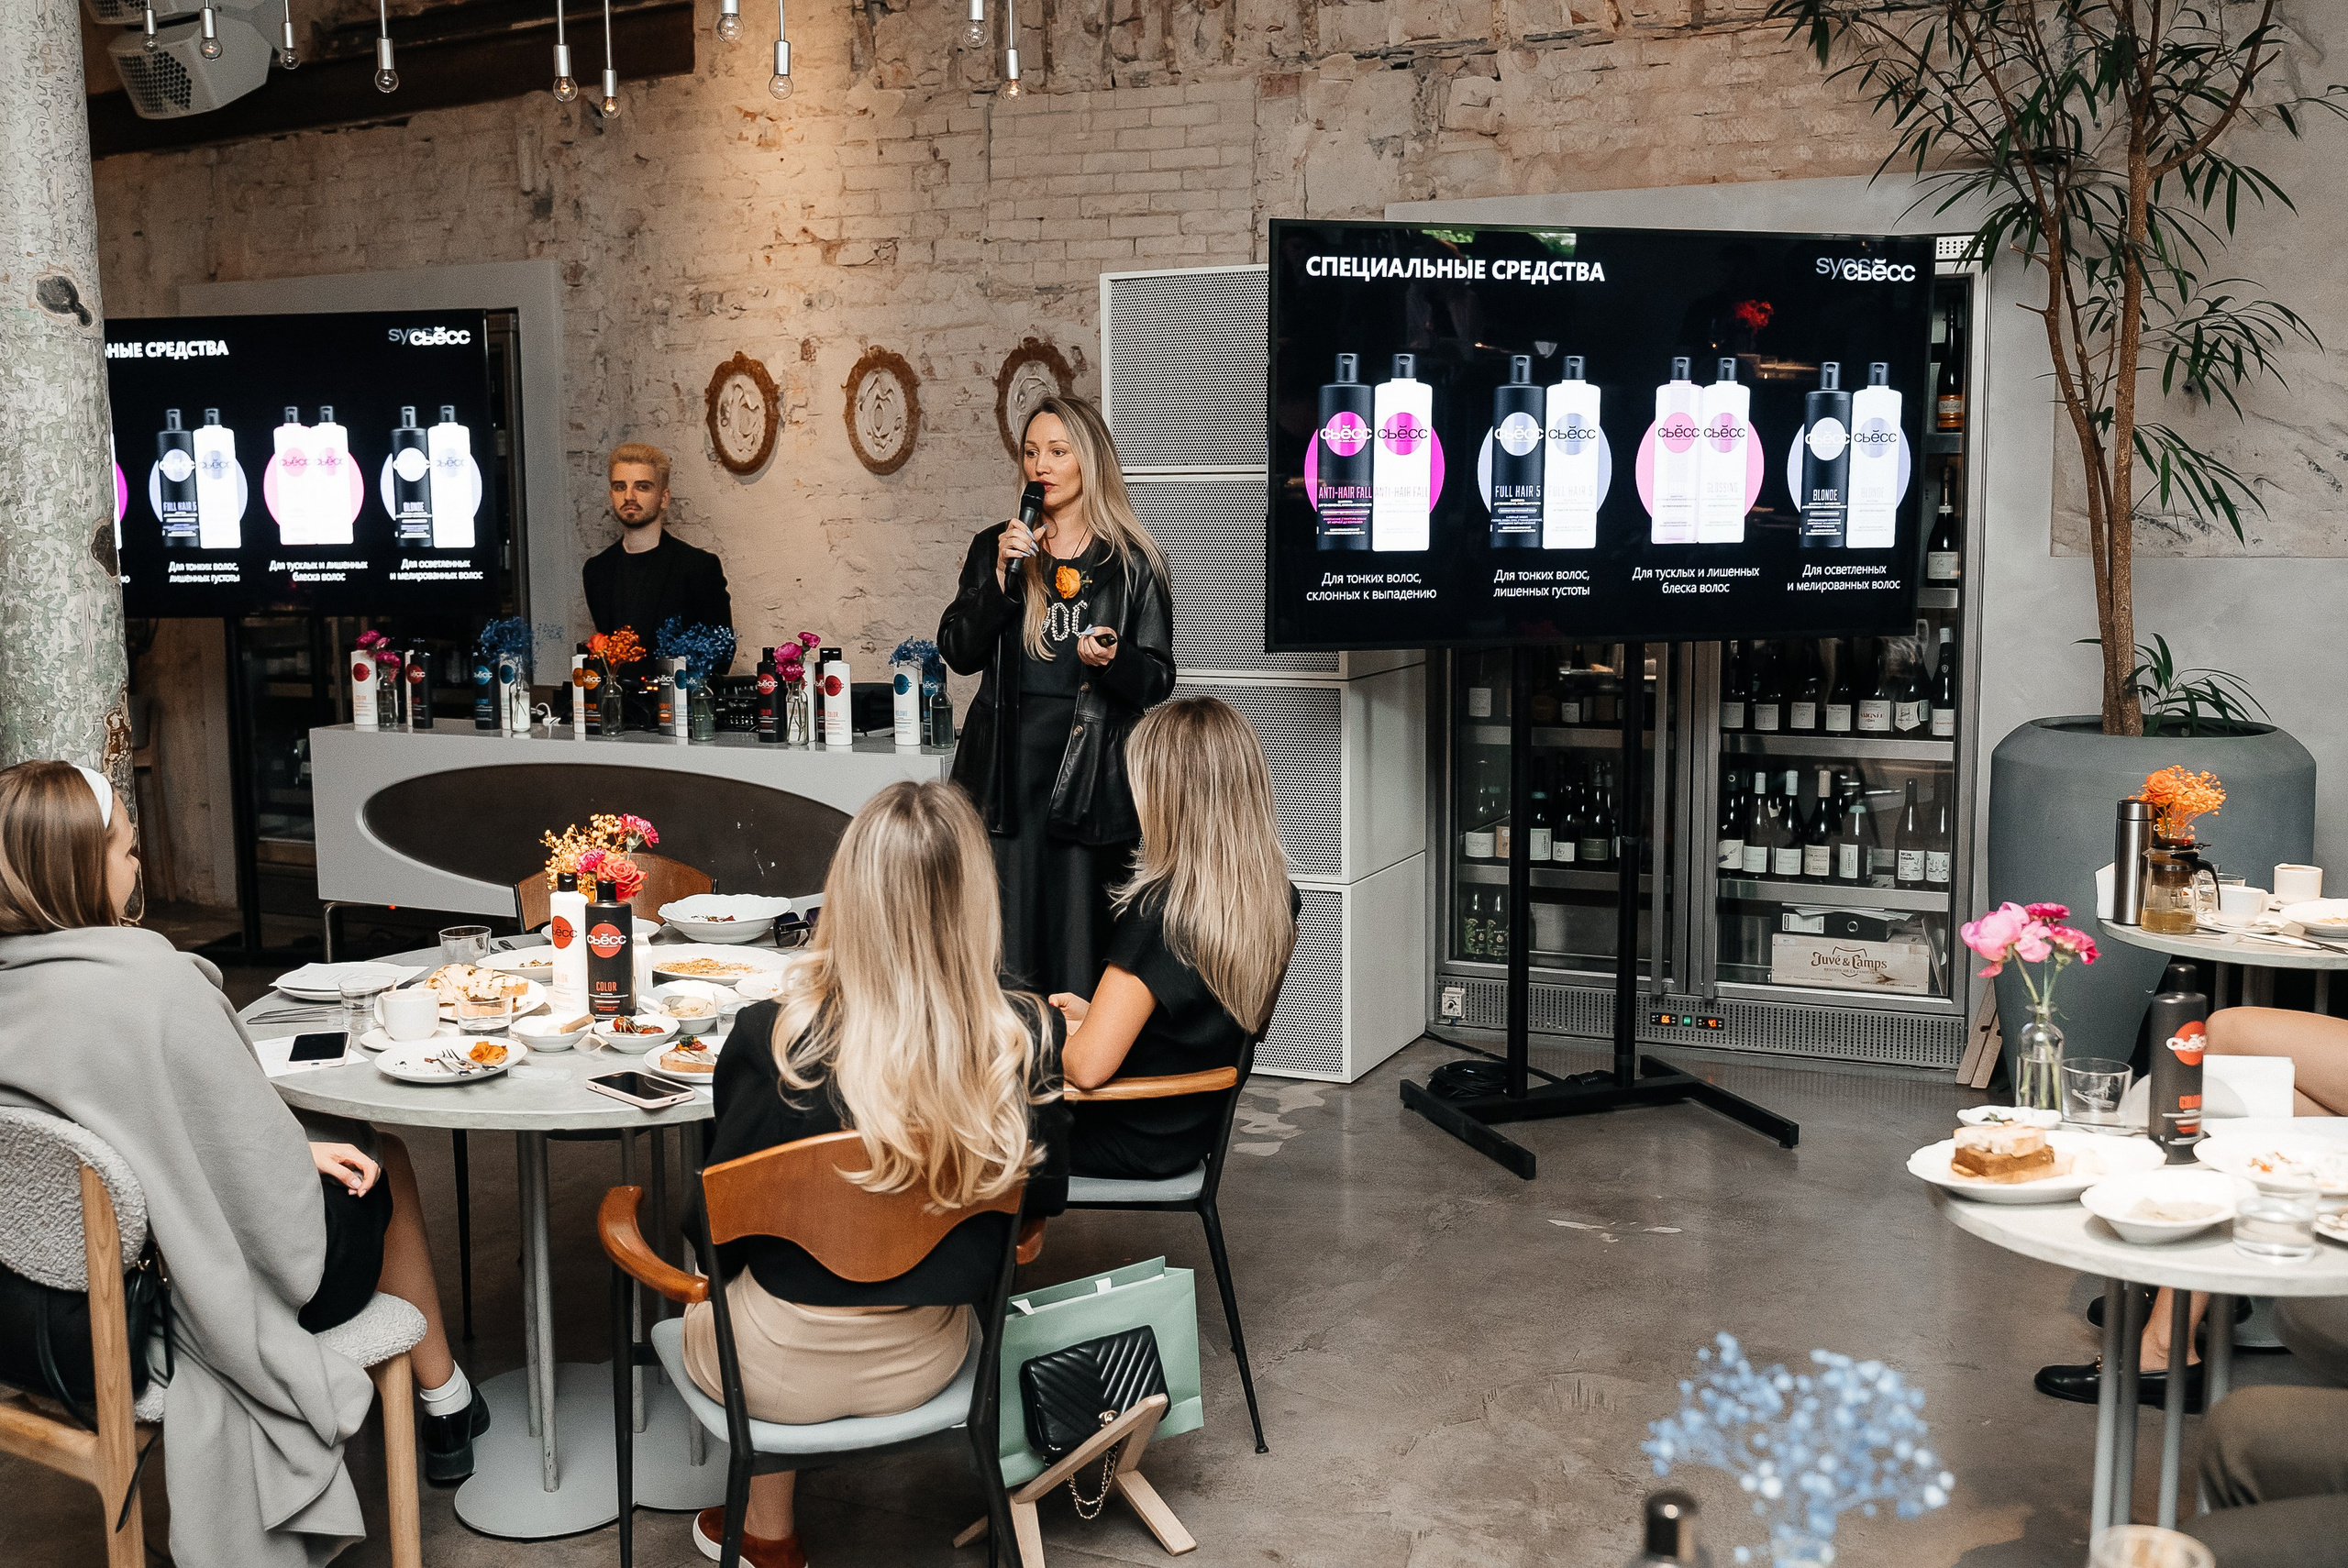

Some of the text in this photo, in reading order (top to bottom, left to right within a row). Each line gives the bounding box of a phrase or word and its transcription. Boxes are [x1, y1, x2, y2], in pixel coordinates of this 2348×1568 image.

[1306, 255, 1605, 285] СПЕЦИАЛЬНЫЕ СРЕДСТВА
[145, 340, 230, 360] СРЕДСТВА
[1319, 486, 1372, 499] ANTI-HAIR FALL
[1495, 485, 1541, 498] FULL HAIR 5
[1812, 489, 1838, 501] BLONDE
[1494, 569, 1590, 583] Для тонких волос,
[1633, 567, 1760, 580] Для тусклых и лишенных
[1802, 564, 1888, 578] Для осветленных
[1321, 572, 1422, 586] Для тонких волос,
[1492, 586, 1590, 599] лишенных густоты
[1662, 582, 1730, 594] блеска волос
[1788, 580, 1901, 593] и мелированных волос
[1306, 589, 1437, 601] склонных к выпадению
[1811, 952, 1888, 971] Juvé & Camps
[596, 981, 618, 992] COLOR
